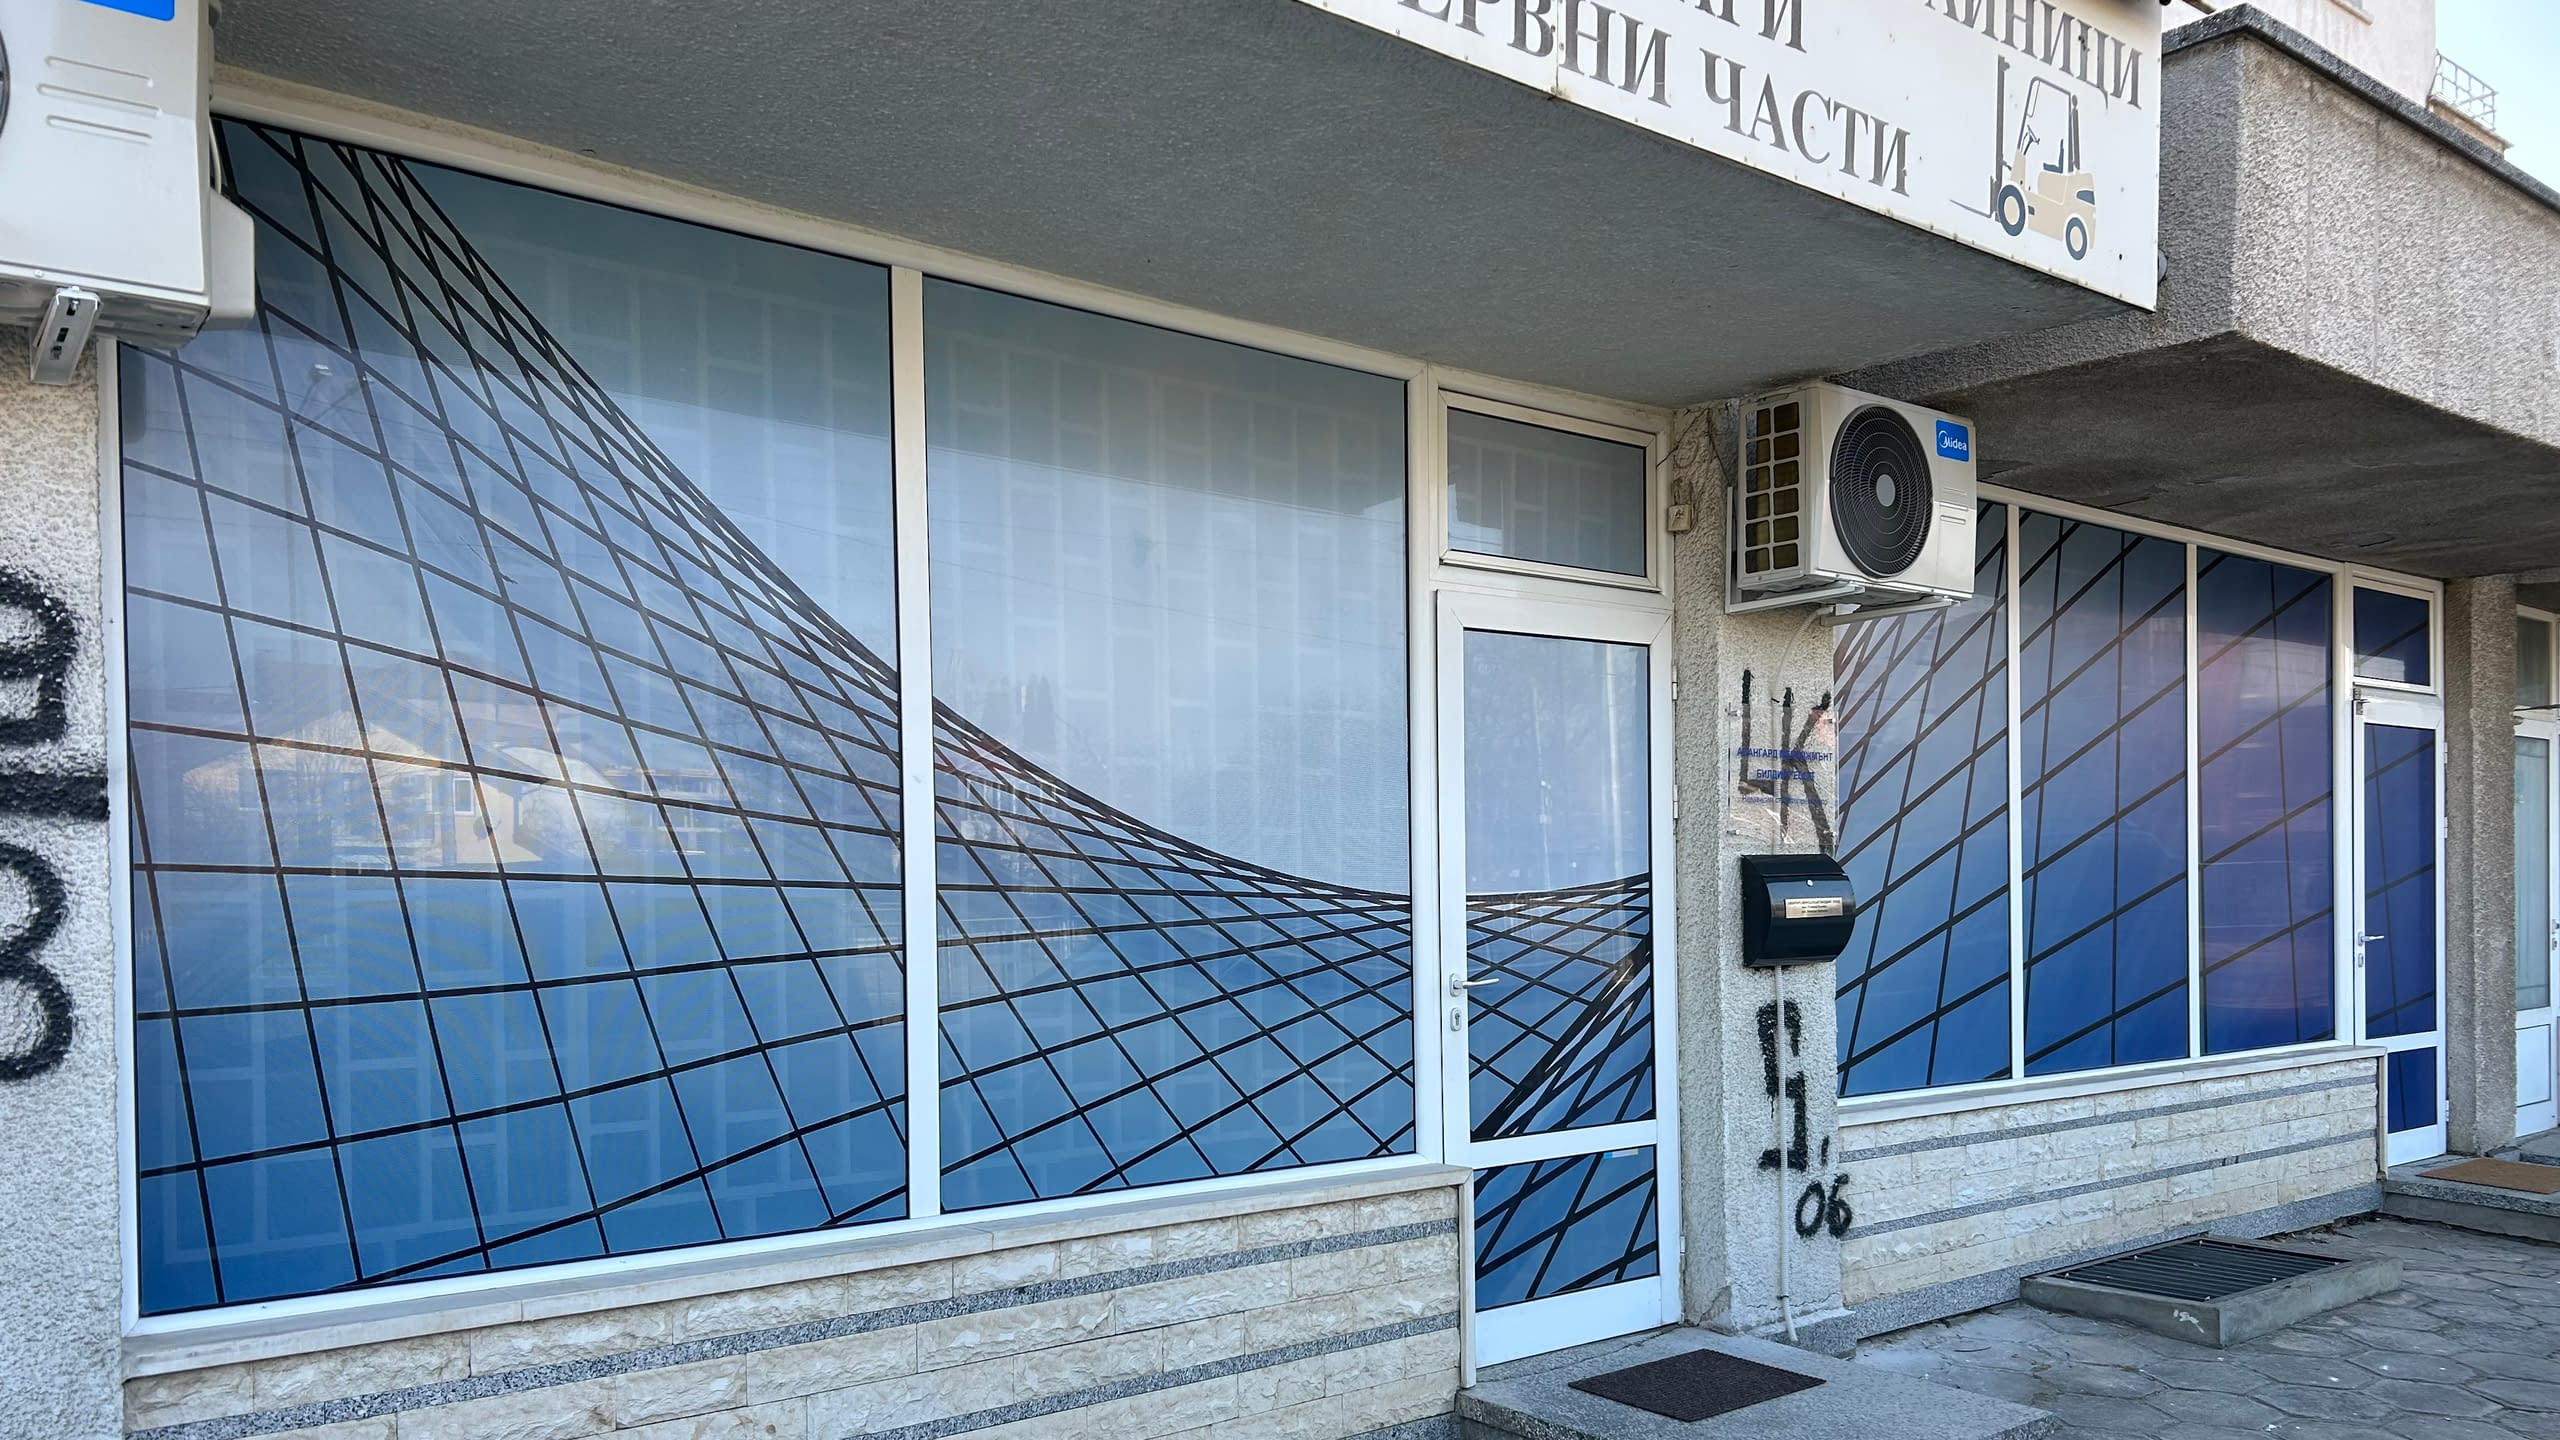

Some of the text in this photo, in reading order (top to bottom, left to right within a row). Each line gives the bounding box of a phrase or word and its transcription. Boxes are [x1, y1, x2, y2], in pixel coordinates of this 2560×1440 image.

[1925, 0, 2143, 110] ИНИЦИ
[1397, 0, 1672, 108] ВНИ
[1699, 47, 1910, 197] ЧАСТИ
[1941, 433, 1967, 451] Midea
[1756, 769, 1790, 781] БИЛДИ
